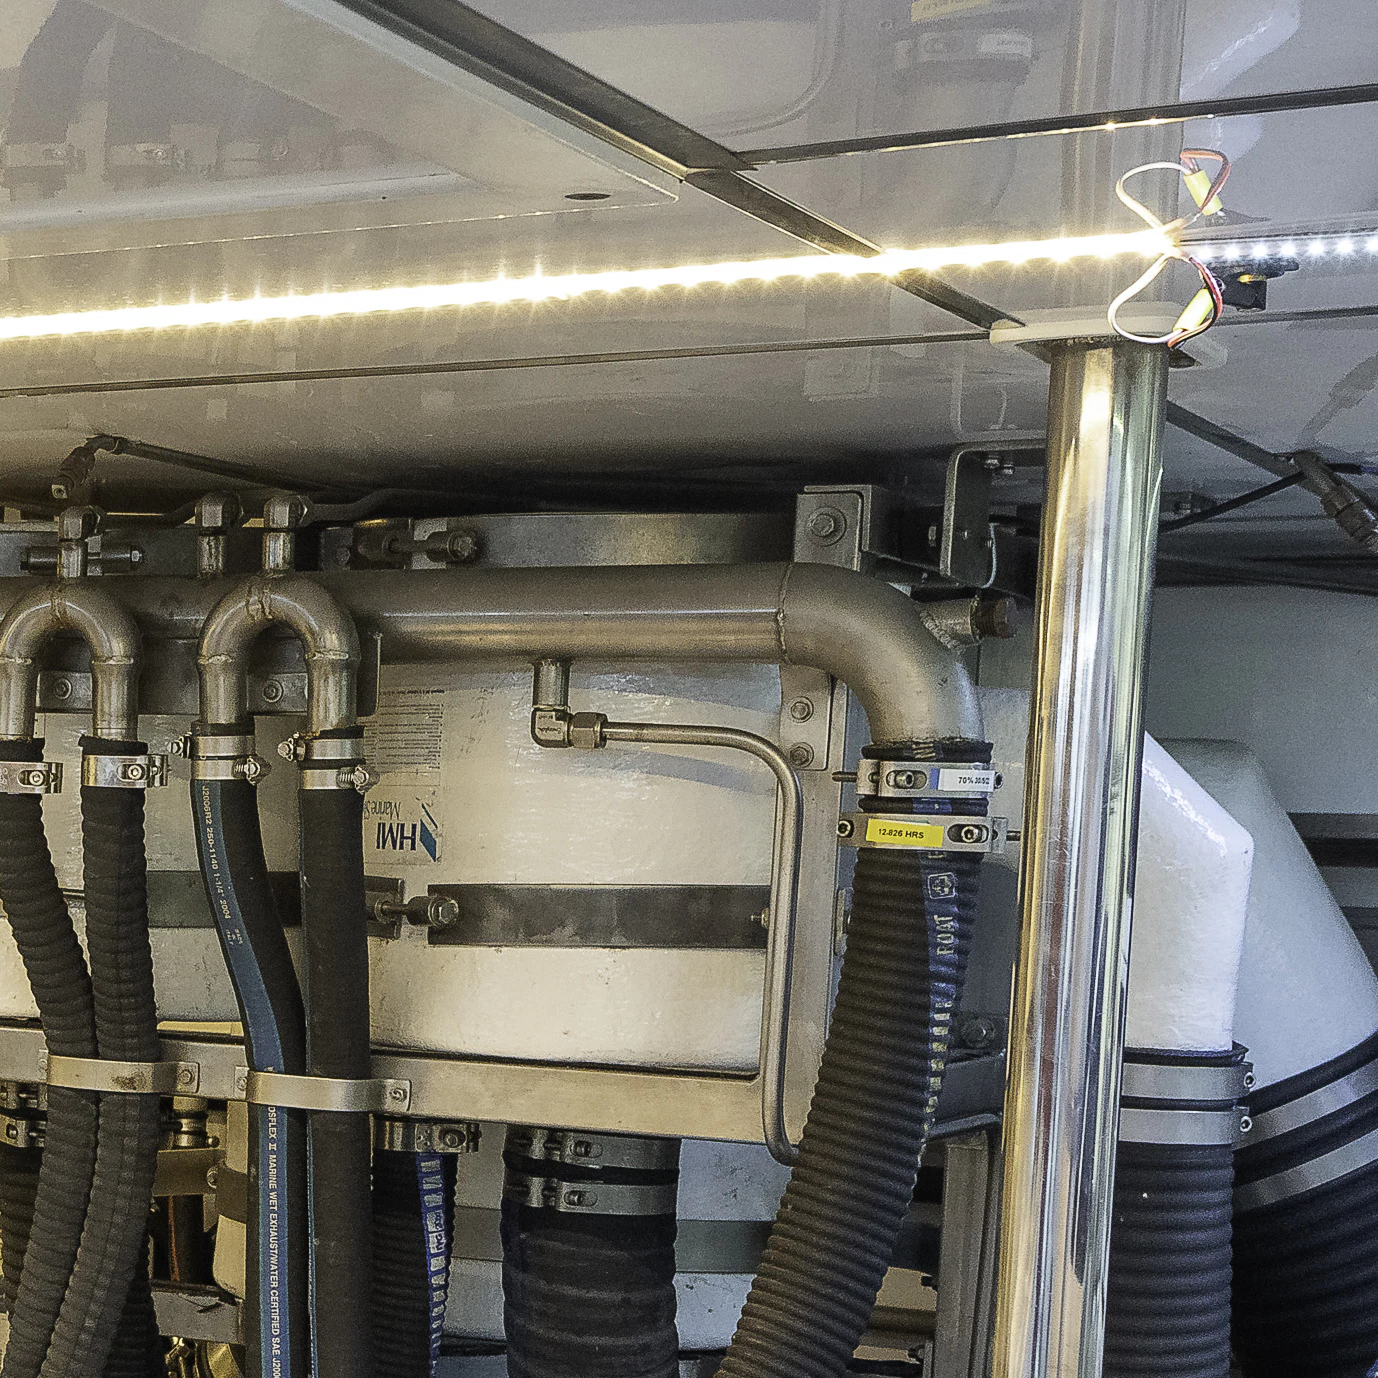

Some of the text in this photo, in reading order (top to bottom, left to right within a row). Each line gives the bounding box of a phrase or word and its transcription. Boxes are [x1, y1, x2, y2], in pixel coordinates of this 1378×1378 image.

[371, 801, 401, 821] Marine
[376, 822, 417, 851] HMI
[905, 830, 925, 839] HRS
[206, 827, 218, 870] 250-1140
[220, 900, 231, 919] 2004
[269, 1154, 278, 1190] MARINE
[269, 1191, 279, 1211] WET
[269, 1213, 280, 1289] EXHAUST/WATER
[270, 1290, 281, 1336] CERTIFIED
[272, 1337, 281, 1356] SAE
